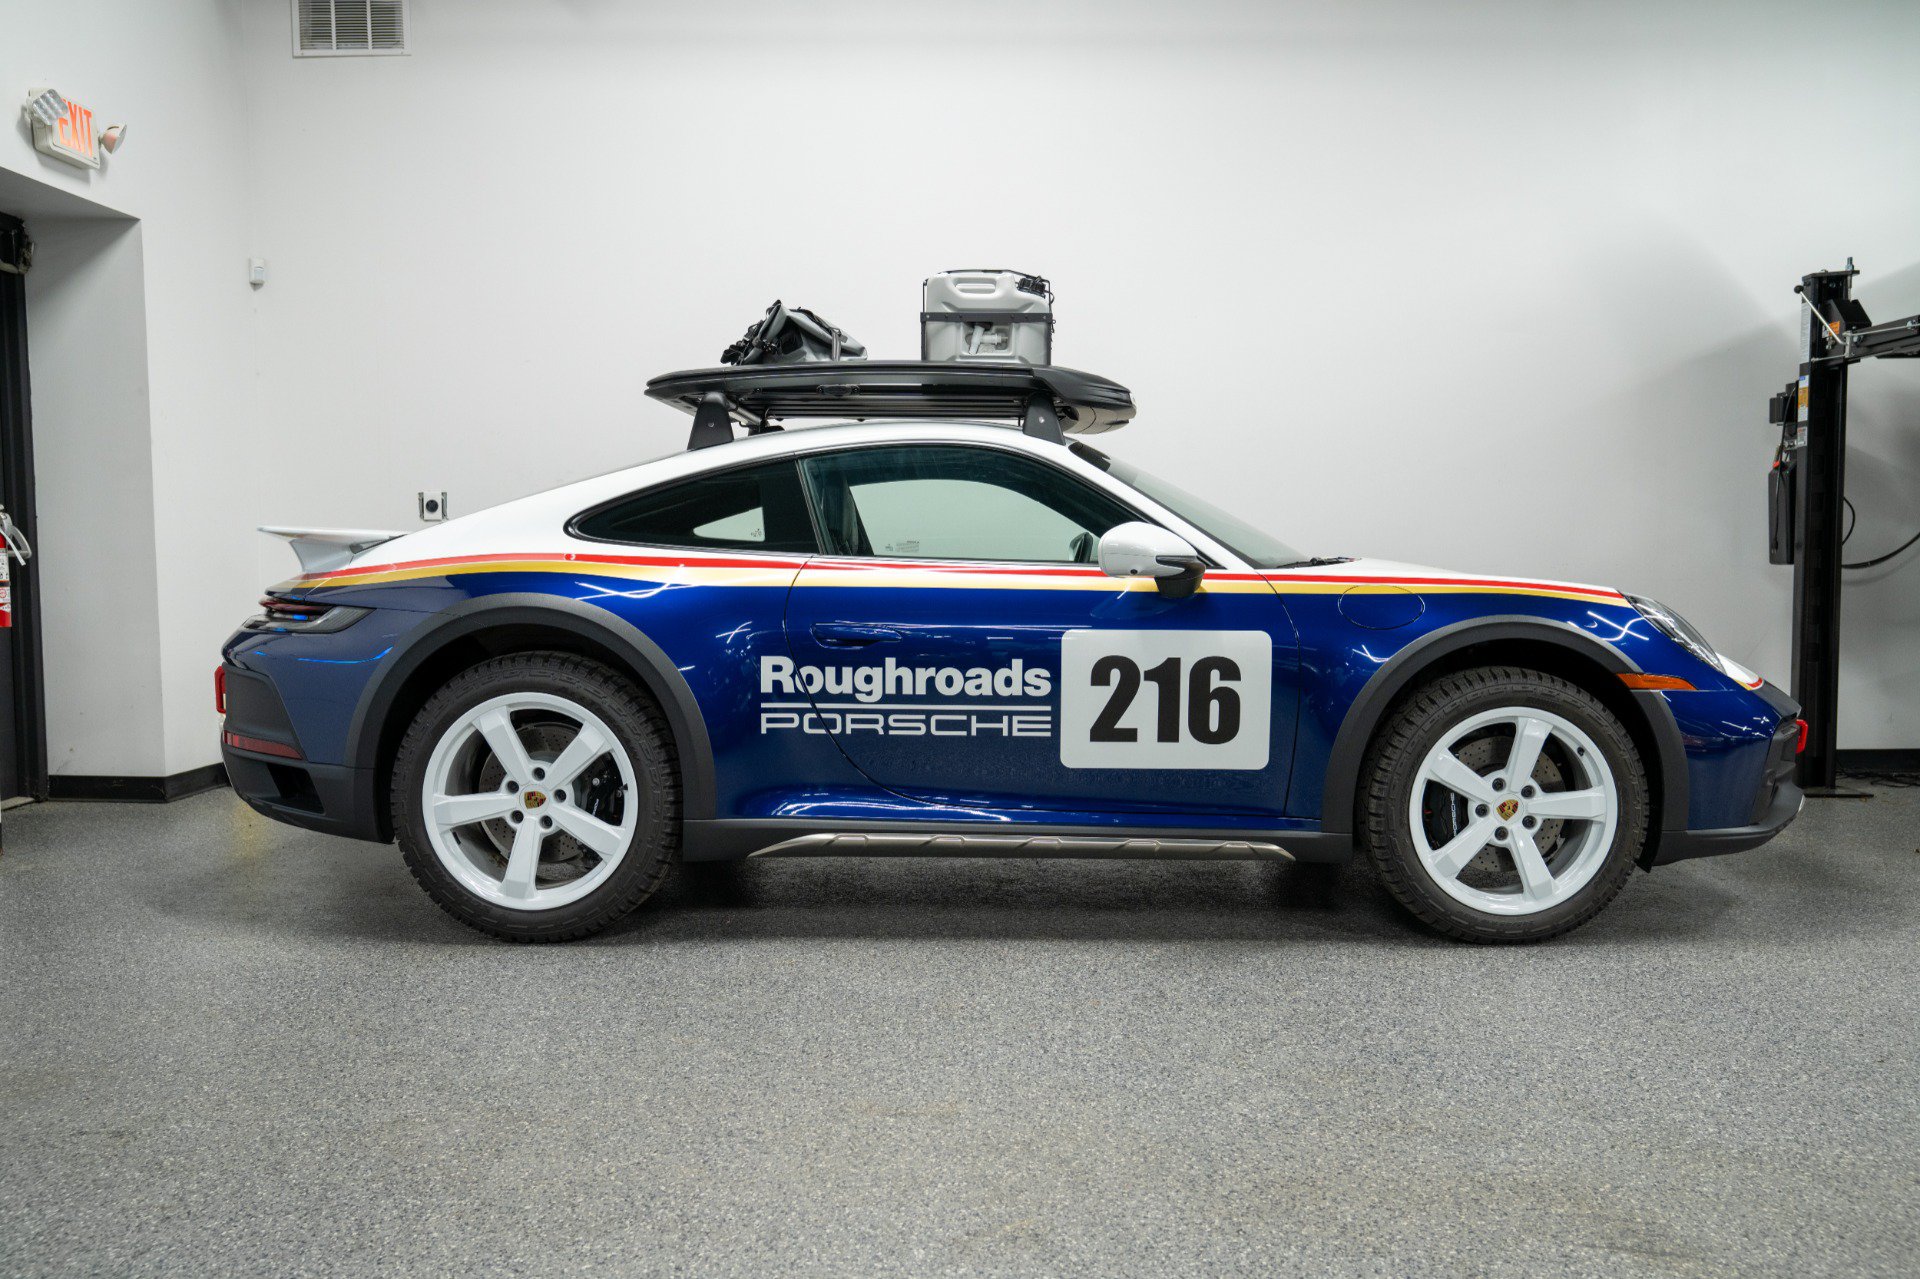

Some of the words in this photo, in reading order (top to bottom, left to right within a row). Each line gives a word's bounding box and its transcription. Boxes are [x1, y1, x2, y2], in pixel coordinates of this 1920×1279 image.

[761, 656, 1052, 702] Roughroads
[1090, 655, 1241, 744] 216
[761, 713, 1052, 737] PORSCHE
